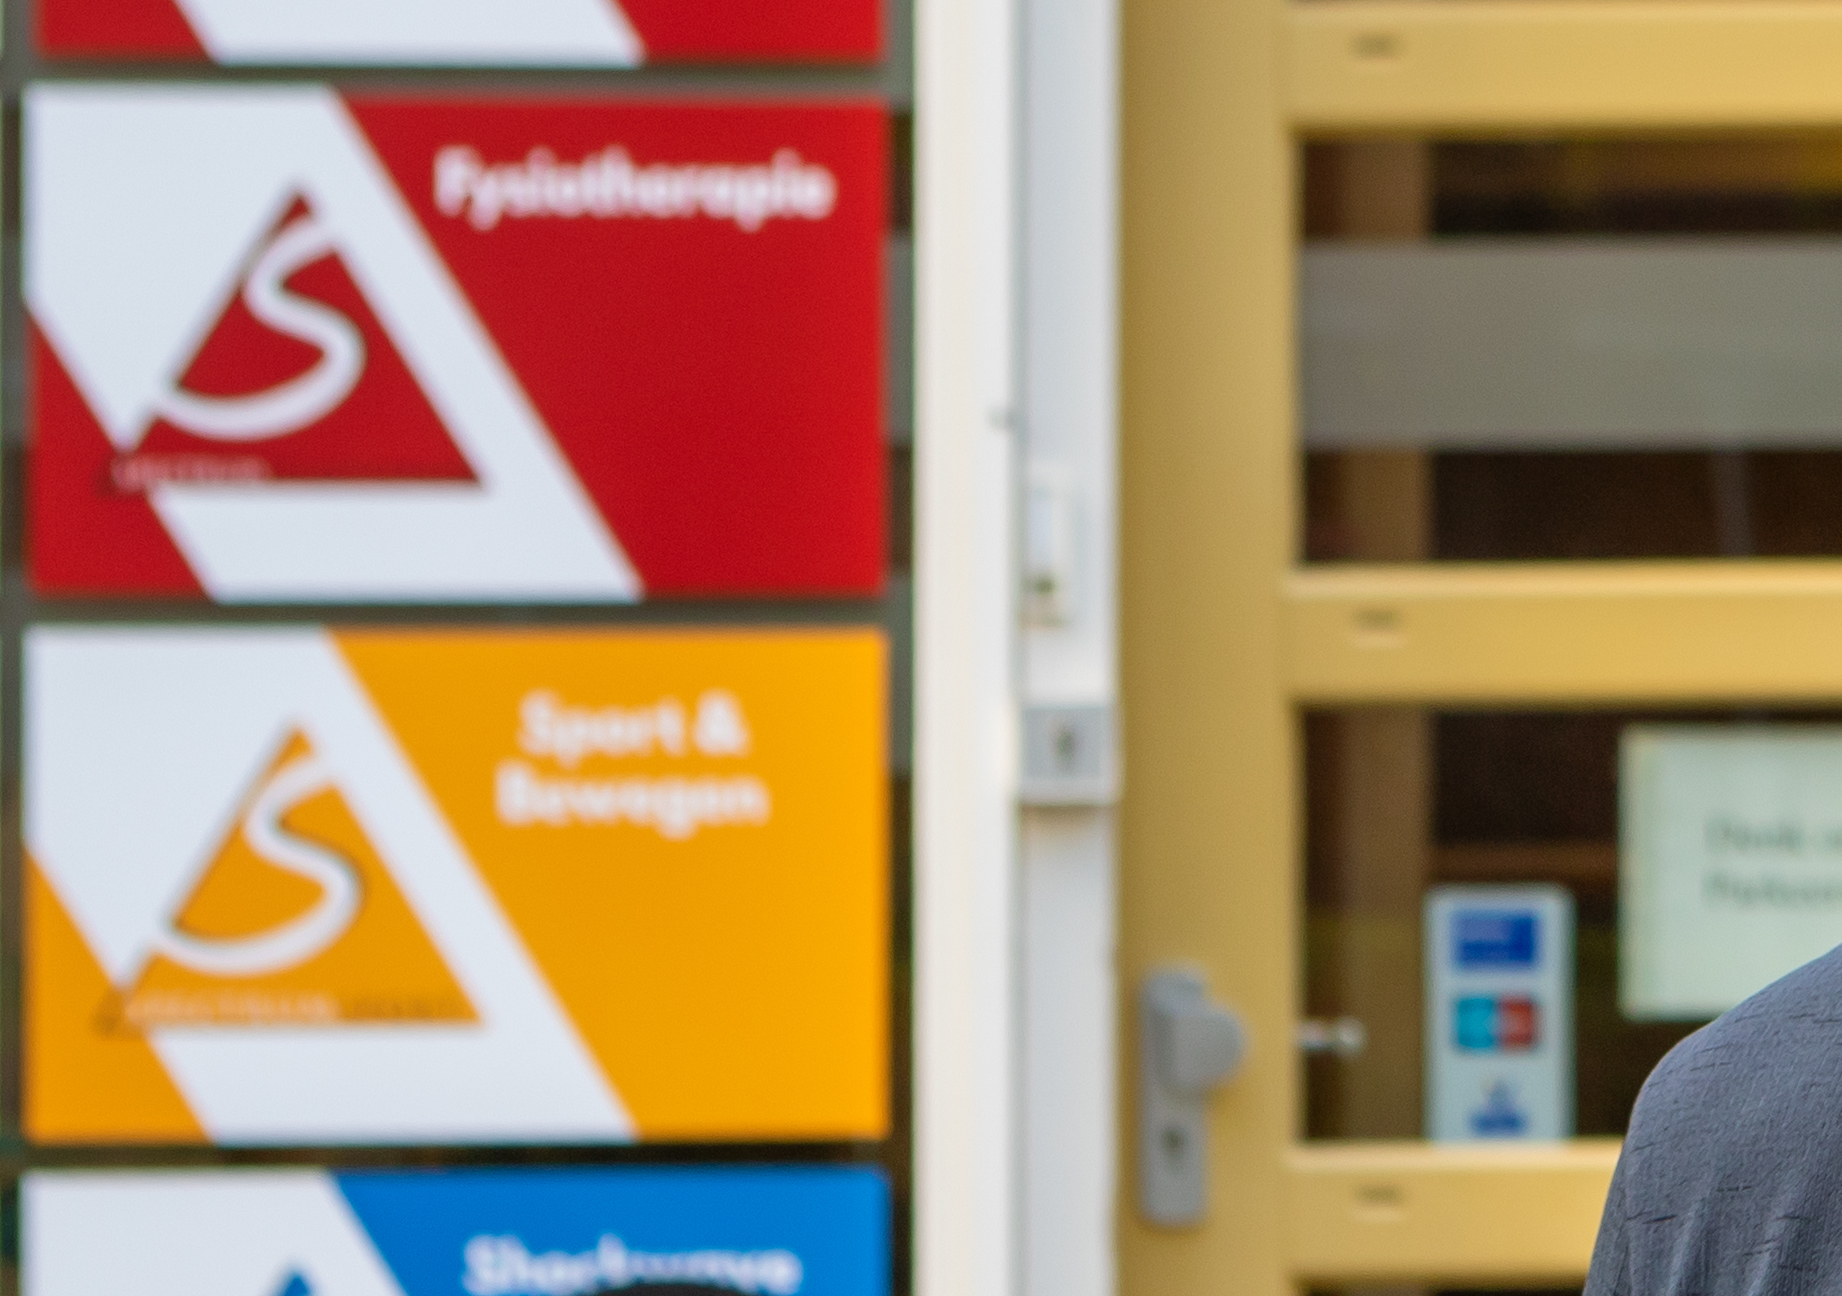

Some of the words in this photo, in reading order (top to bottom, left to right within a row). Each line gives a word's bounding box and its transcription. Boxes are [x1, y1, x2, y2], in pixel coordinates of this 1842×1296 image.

[433, 145, 836, 232] Fysiotherapie
[518, 692, 684, 770] Sport
[693, 689, 750, 759] &
[496, 760, 771, 841] Bewegen
